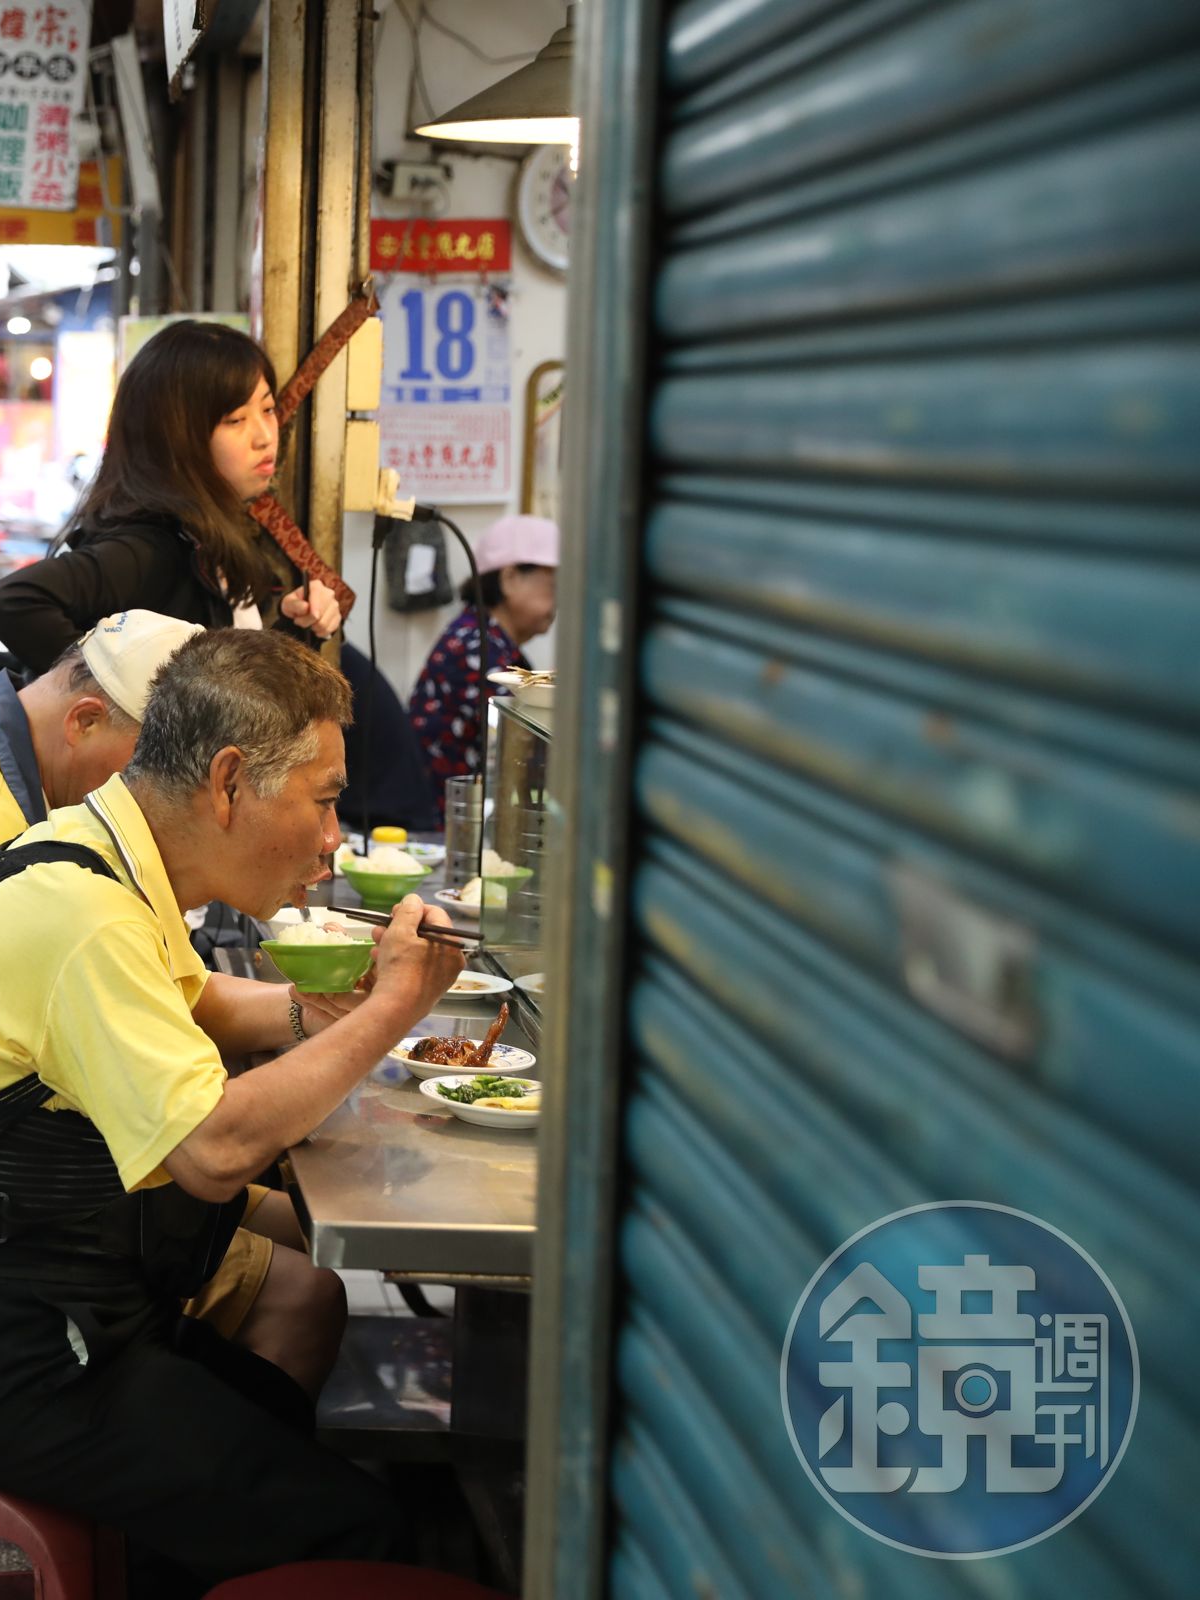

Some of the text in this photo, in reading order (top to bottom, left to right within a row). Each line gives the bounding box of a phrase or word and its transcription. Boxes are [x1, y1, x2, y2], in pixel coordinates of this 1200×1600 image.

[31, 104, 71, 203] 清粥小菜
[400, 288, 475, 380] 18
